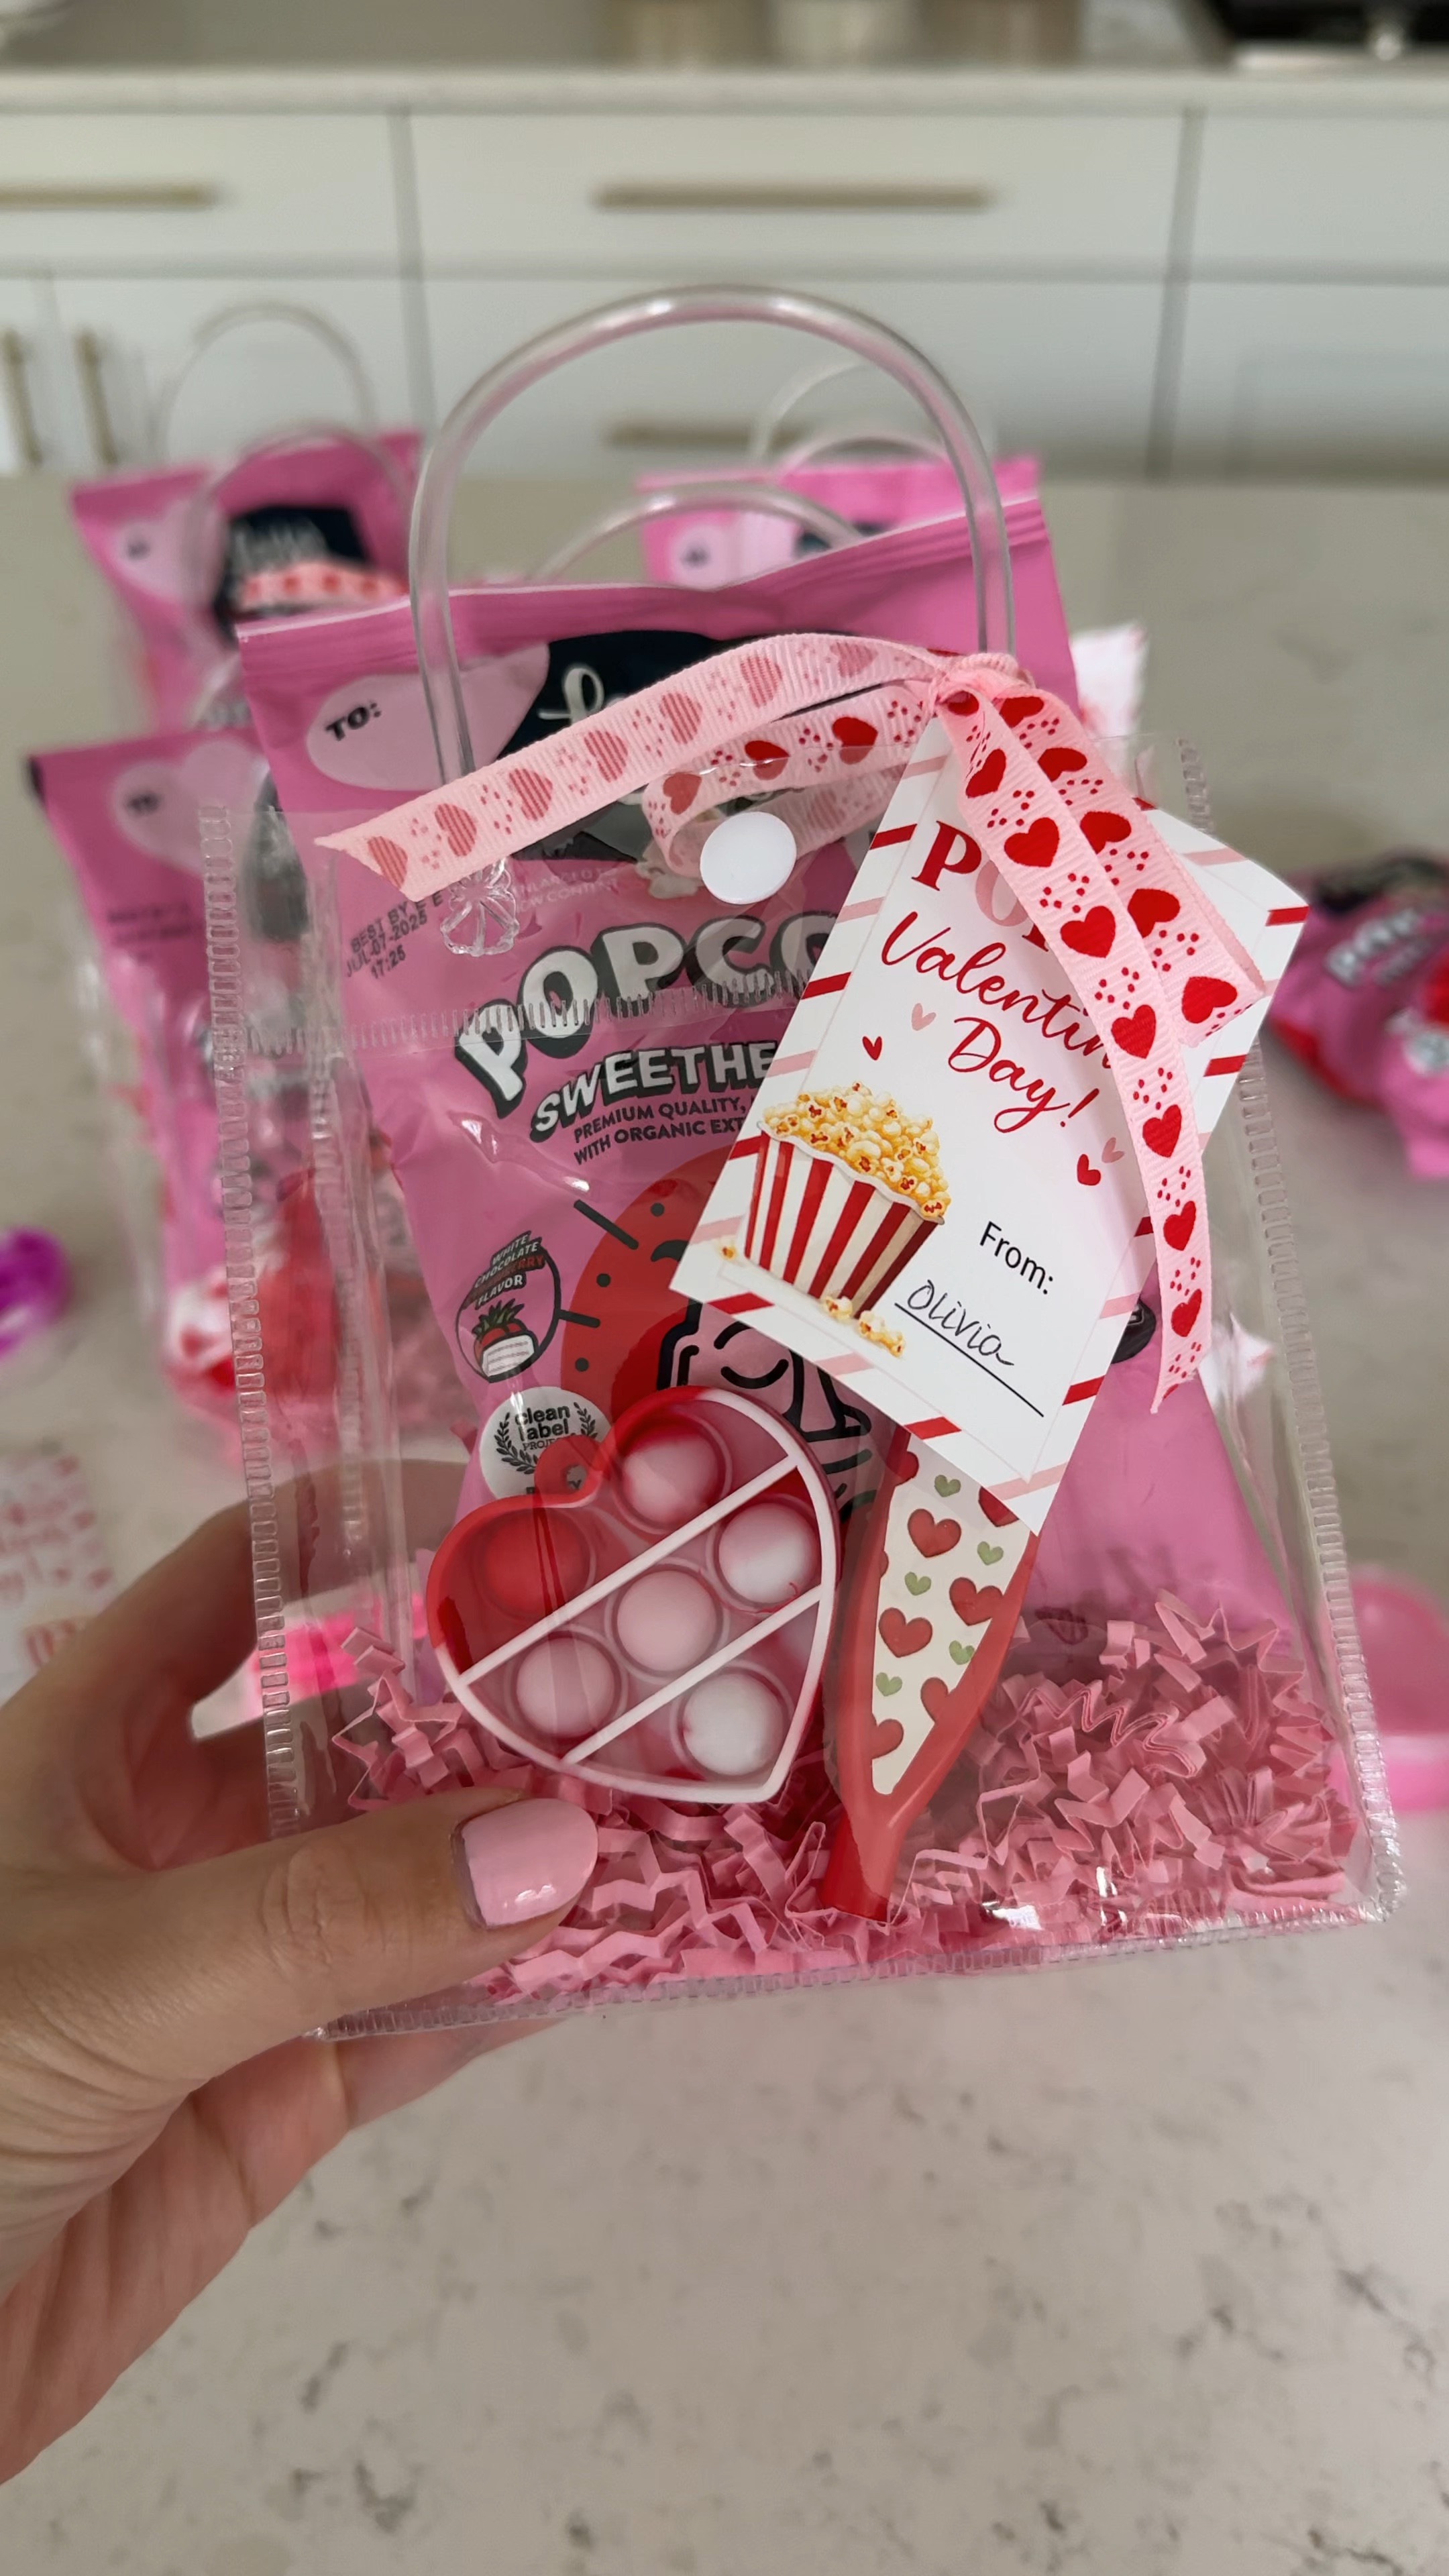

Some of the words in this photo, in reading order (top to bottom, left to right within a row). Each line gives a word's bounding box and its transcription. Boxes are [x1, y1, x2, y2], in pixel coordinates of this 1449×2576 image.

[325, 702, 382, 742] TO:
[912, 820, 1049, 953] PO
[352, 918, 385, 953] BEST
[388, 901, 409, 924] BY
[533, 1042, 777, 1138] SWEETHE
[948, 1017, 1100, 1134] Day!
[574, 1105, 655, 1144] PREMIUM
[659, 1097, 747, 1120] QUALITY,
[574, 1135, 611, 1165] WITH
[614, 1120, 706, 1144] ORGANIC
[474, 1241, 539, 1289] CHOCOLATE
[492, 1234, 529, 1265] WHITE
[979, 1221, 1054, 1295] From:
[478, 1275, 523, 1306] FLAVOR
[907, 1279, 1015, 1366] Olivia
[515, 1405, 571, 1426] clean
[518, 1418, 570, 1442] label
